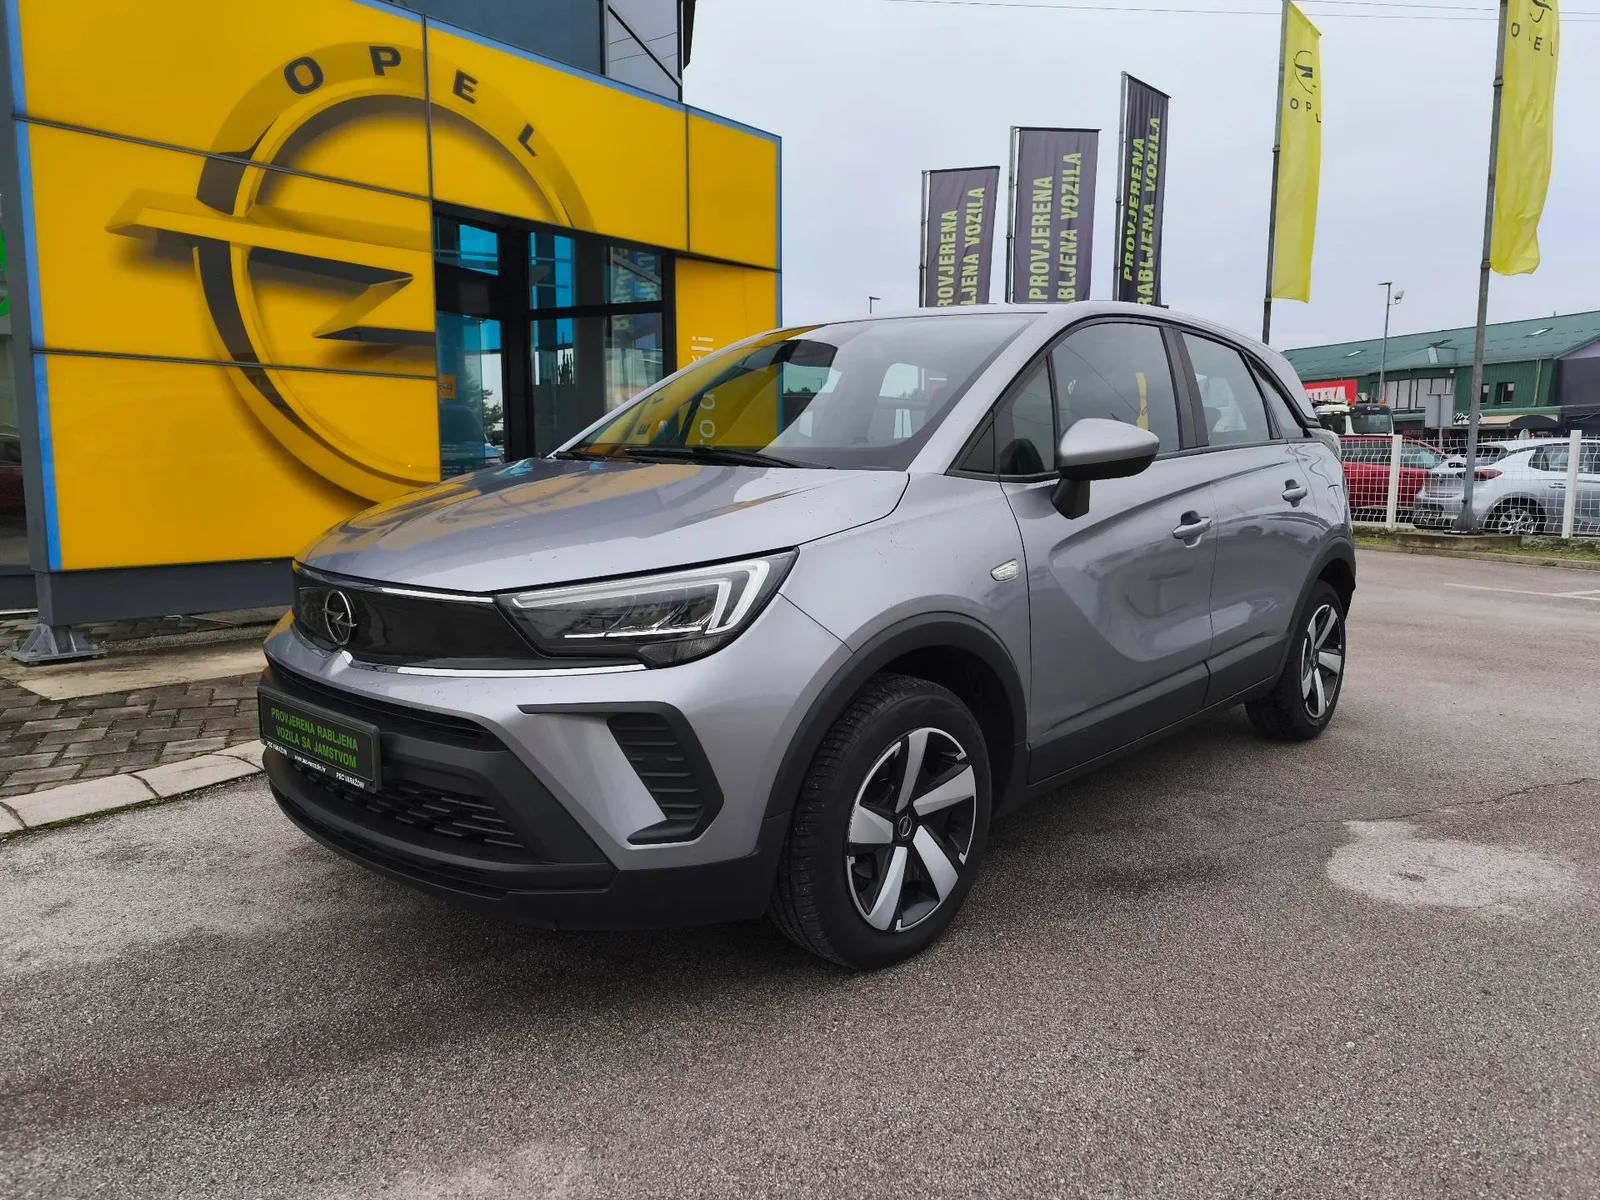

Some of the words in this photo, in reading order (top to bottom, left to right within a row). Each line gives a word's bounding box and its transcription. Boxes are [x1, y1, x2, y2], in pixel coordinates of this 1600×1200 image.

[1511, 22, 1554, 57] OEL
[283, 45, 538, 158] OPEL
[1290, 97, 1322, 123] OPL
[1060, 152, 1082, 220] VOZILA
[1145, 117, 1161, 192] VOZILA
[965, 187, 985, 248] VOZILA
[1028, 176, 1053, 300] PROVJERENA
[1123, 138, 1145, 281] PROVJERENA
[937, 210, 958, 307] ROVJERENA
[960, 253, 980, 305] LJENA
[1057, 229, 1078, 302] BLJENA
[271, 707, 315, 735] PROVJERENA
[317, 726, 359, 751] RABLJENA
[276, 726, 300, 745] VOZILA
[301, 736, 312, 751] SA
[313, 741, 357, 768] JAMSTVOM
